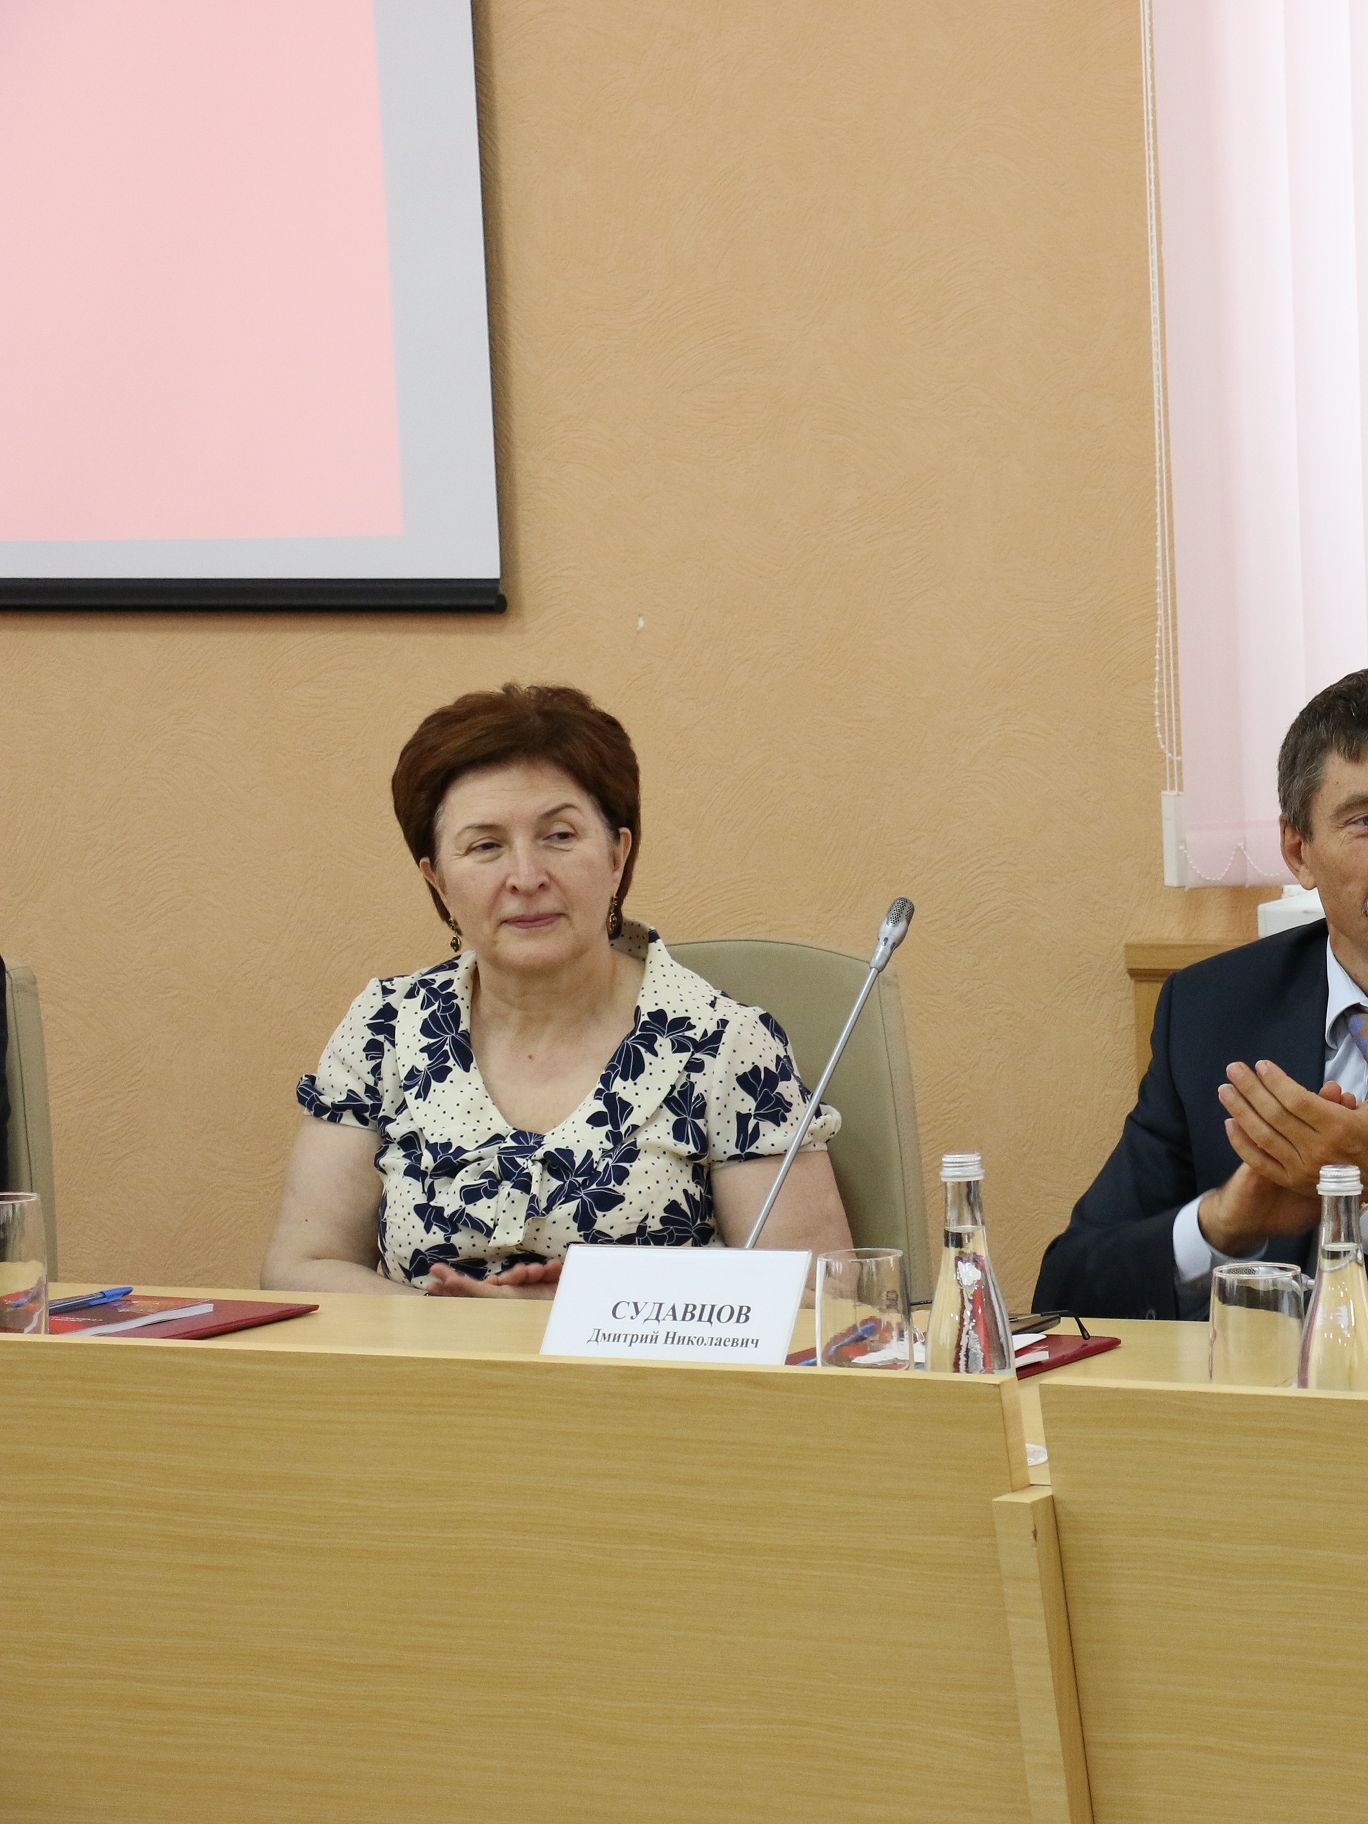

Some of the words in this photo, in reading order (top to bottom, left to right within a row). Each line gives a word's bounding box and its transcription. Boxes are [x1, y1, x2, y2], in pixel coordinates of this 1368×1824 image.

[611, 1301, 752, 1327] СУДАВЦОВ
[587, 1328, 660, 1347] Дмитрий
[663, 1331, 760, 1349] Николаевич
